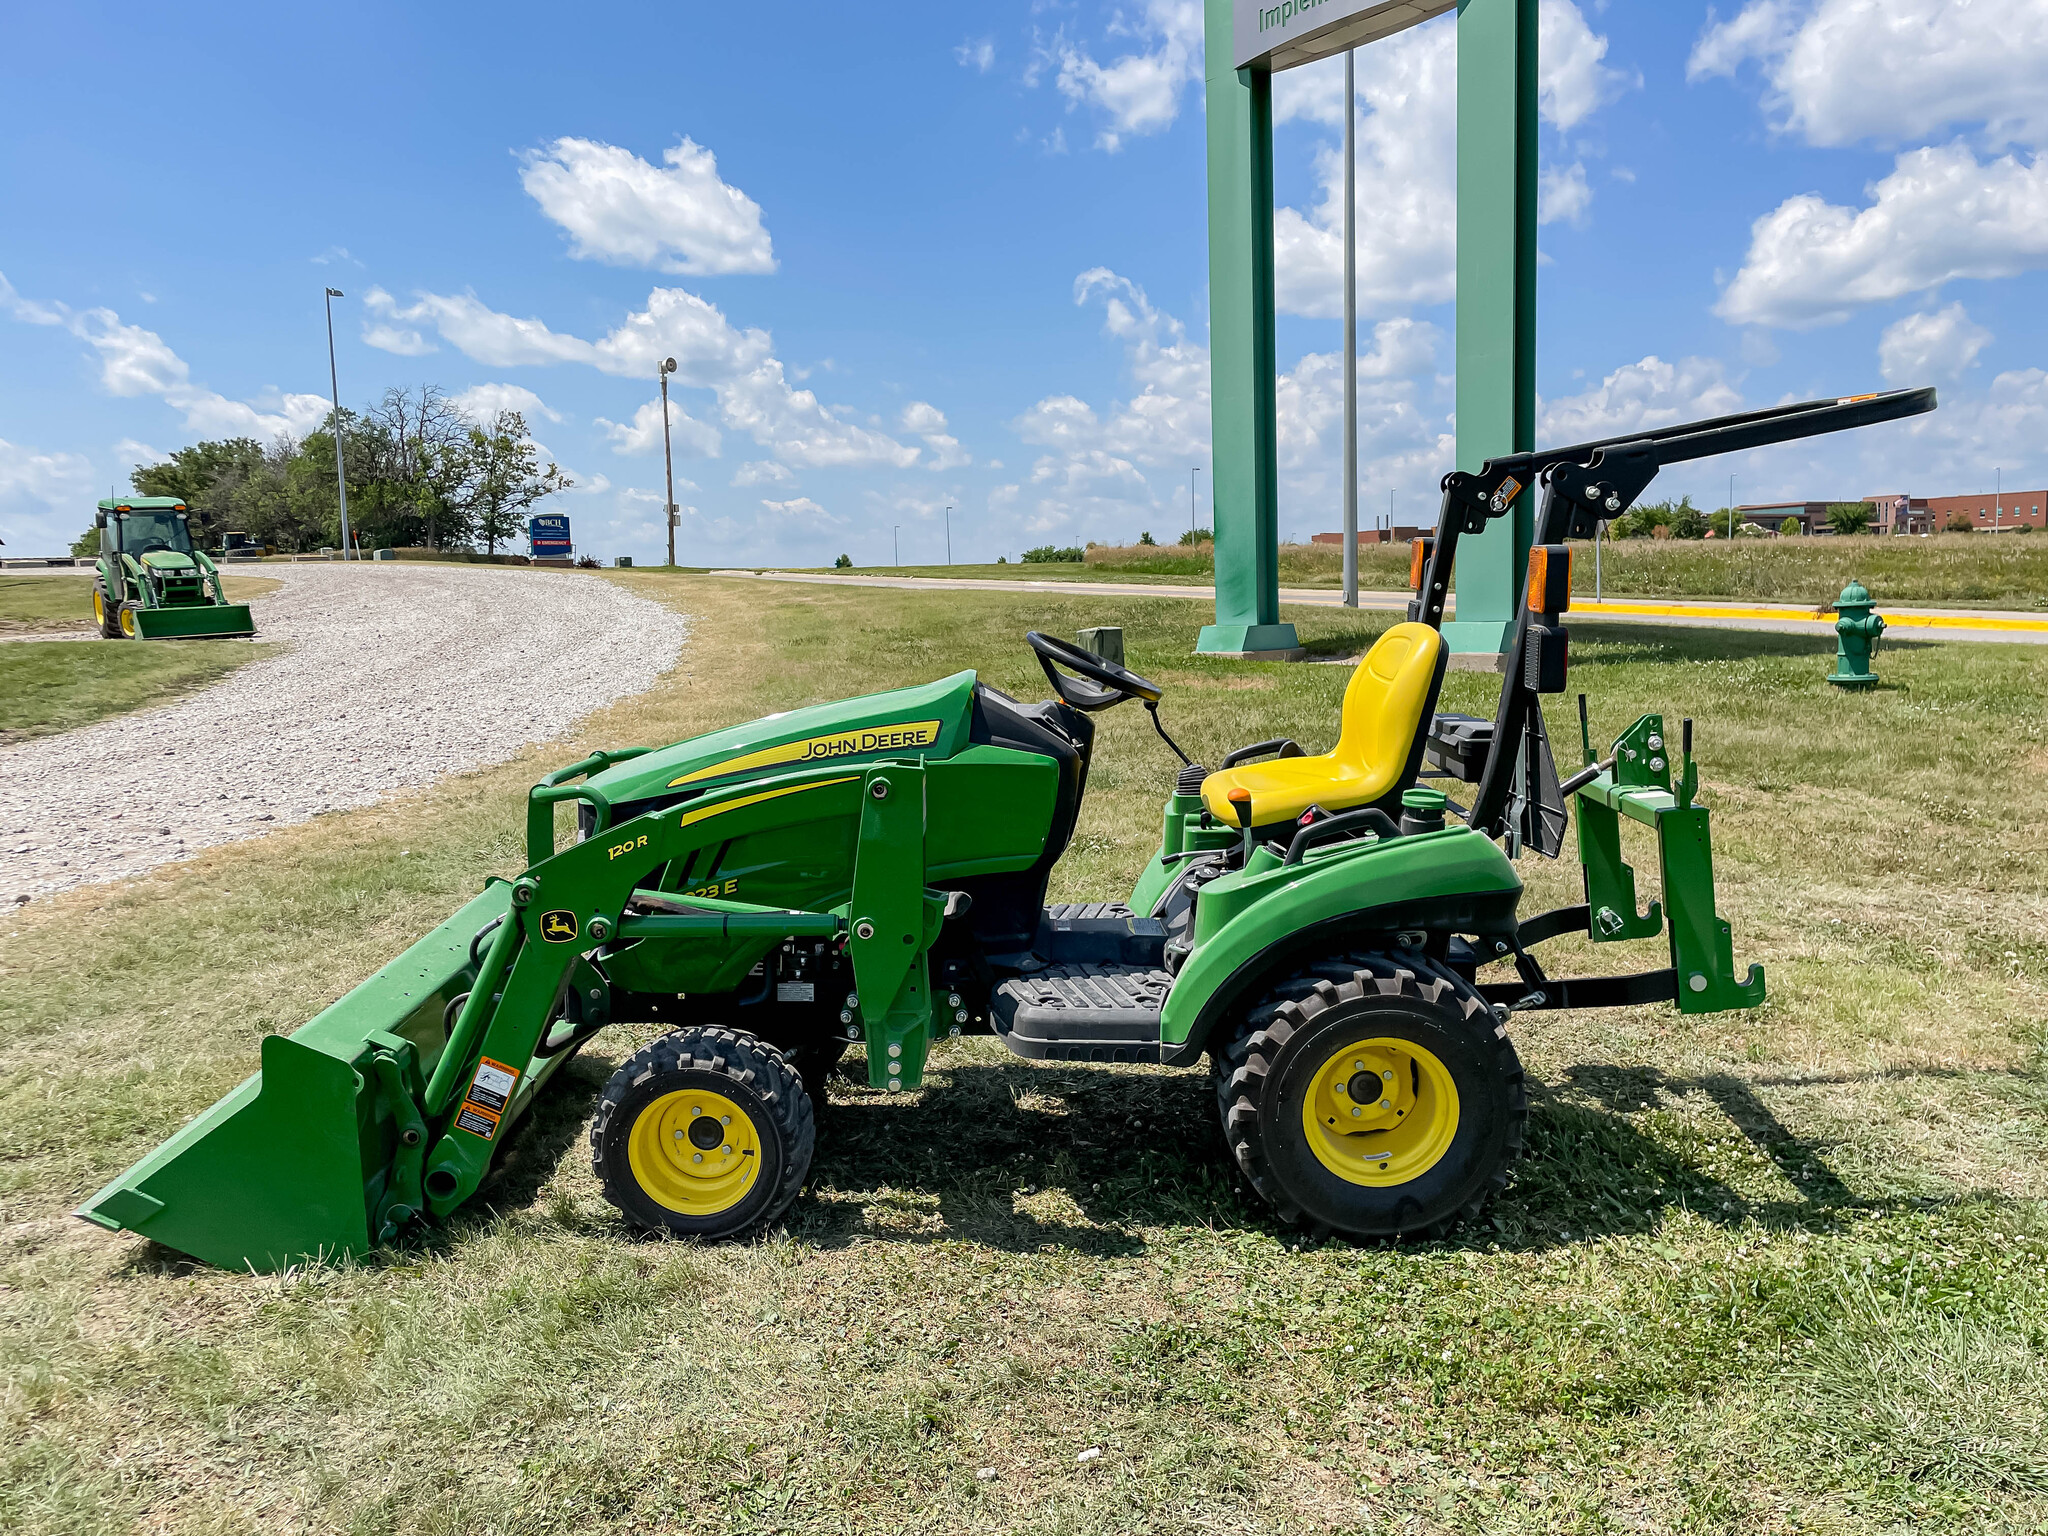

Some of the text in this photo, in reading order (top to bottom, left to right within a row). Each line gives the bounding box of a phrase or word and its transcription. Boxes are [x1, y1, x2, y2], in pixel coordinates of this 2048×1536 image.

[800, 730, 929, 759] JOHN DEERE
[607, 834, 649, 861] 120 R
[684, 879, 738, 898] 23 E
[491, 1061, 515, 1075] WARNING
[472, 1106, 497, 1121] WARNING
